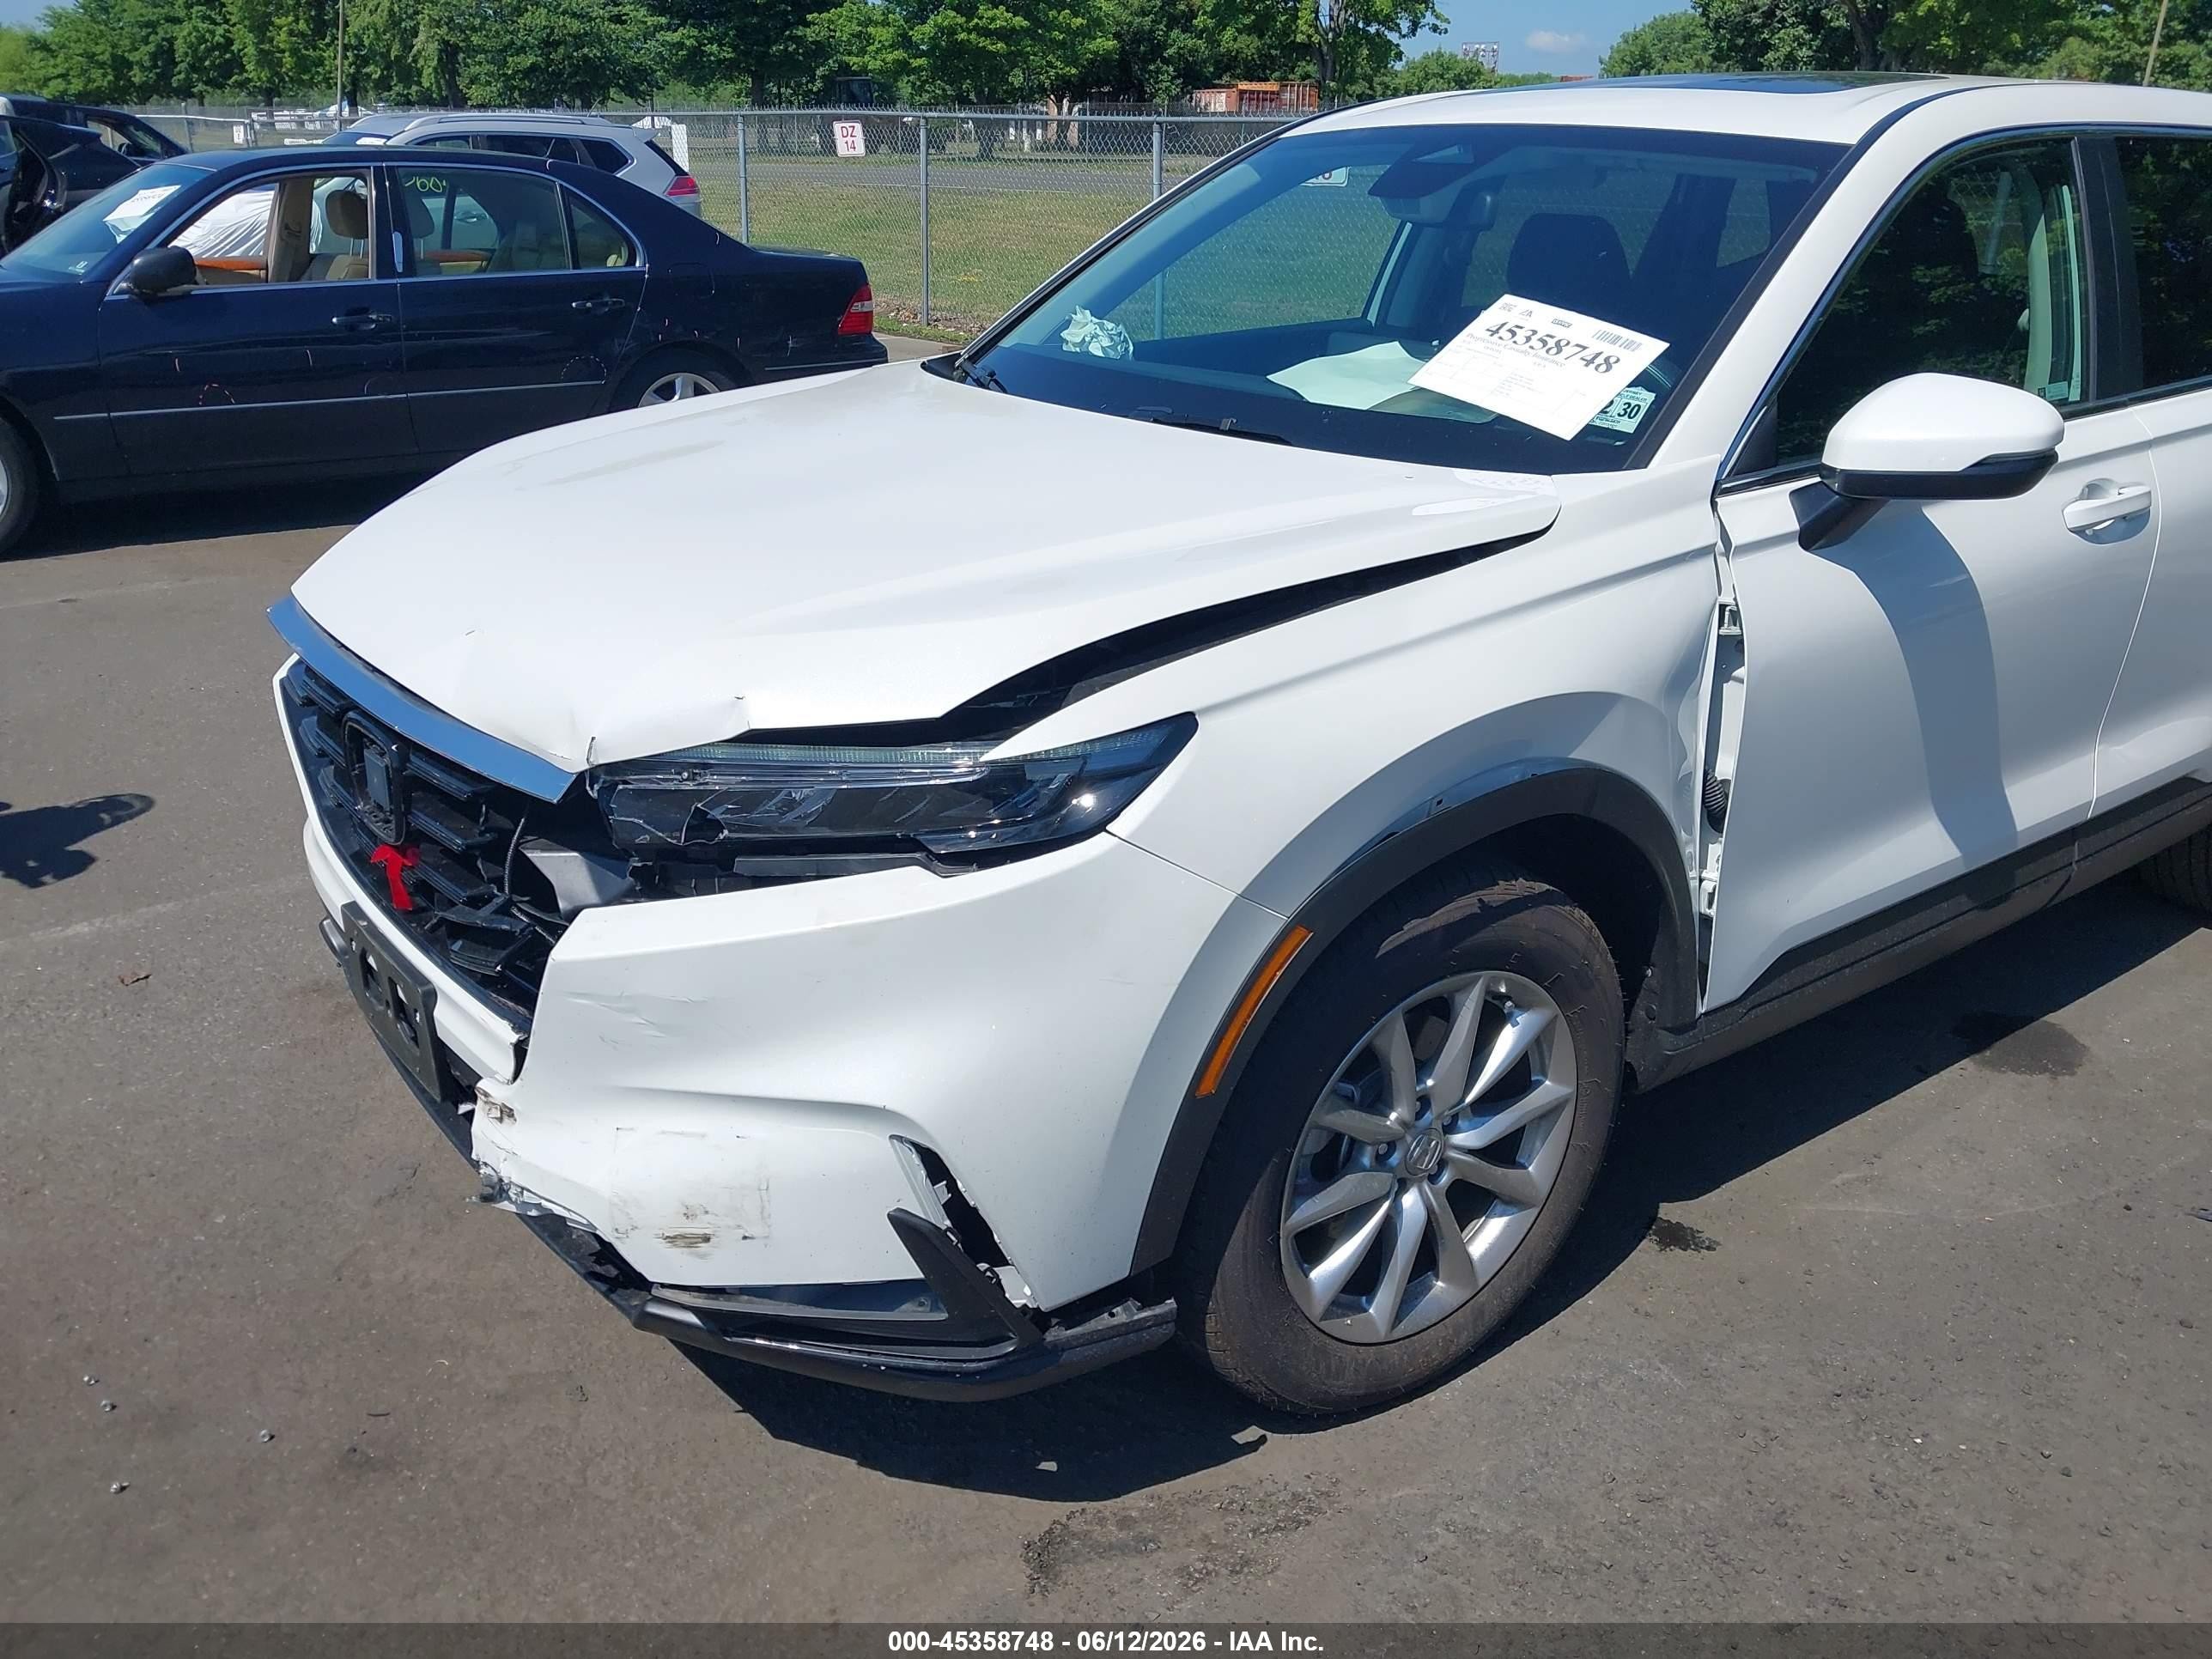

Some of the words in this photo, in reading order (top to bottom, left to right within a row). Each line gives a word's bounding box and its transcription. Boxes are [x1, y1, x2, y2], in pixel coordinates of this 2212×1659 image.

[841, 125, 857, 138] DZ
[844, 139, 856, 152] 14
[1484, 320, 1621, 374] 45358748
[1617, 402, 1642, 420] 30
